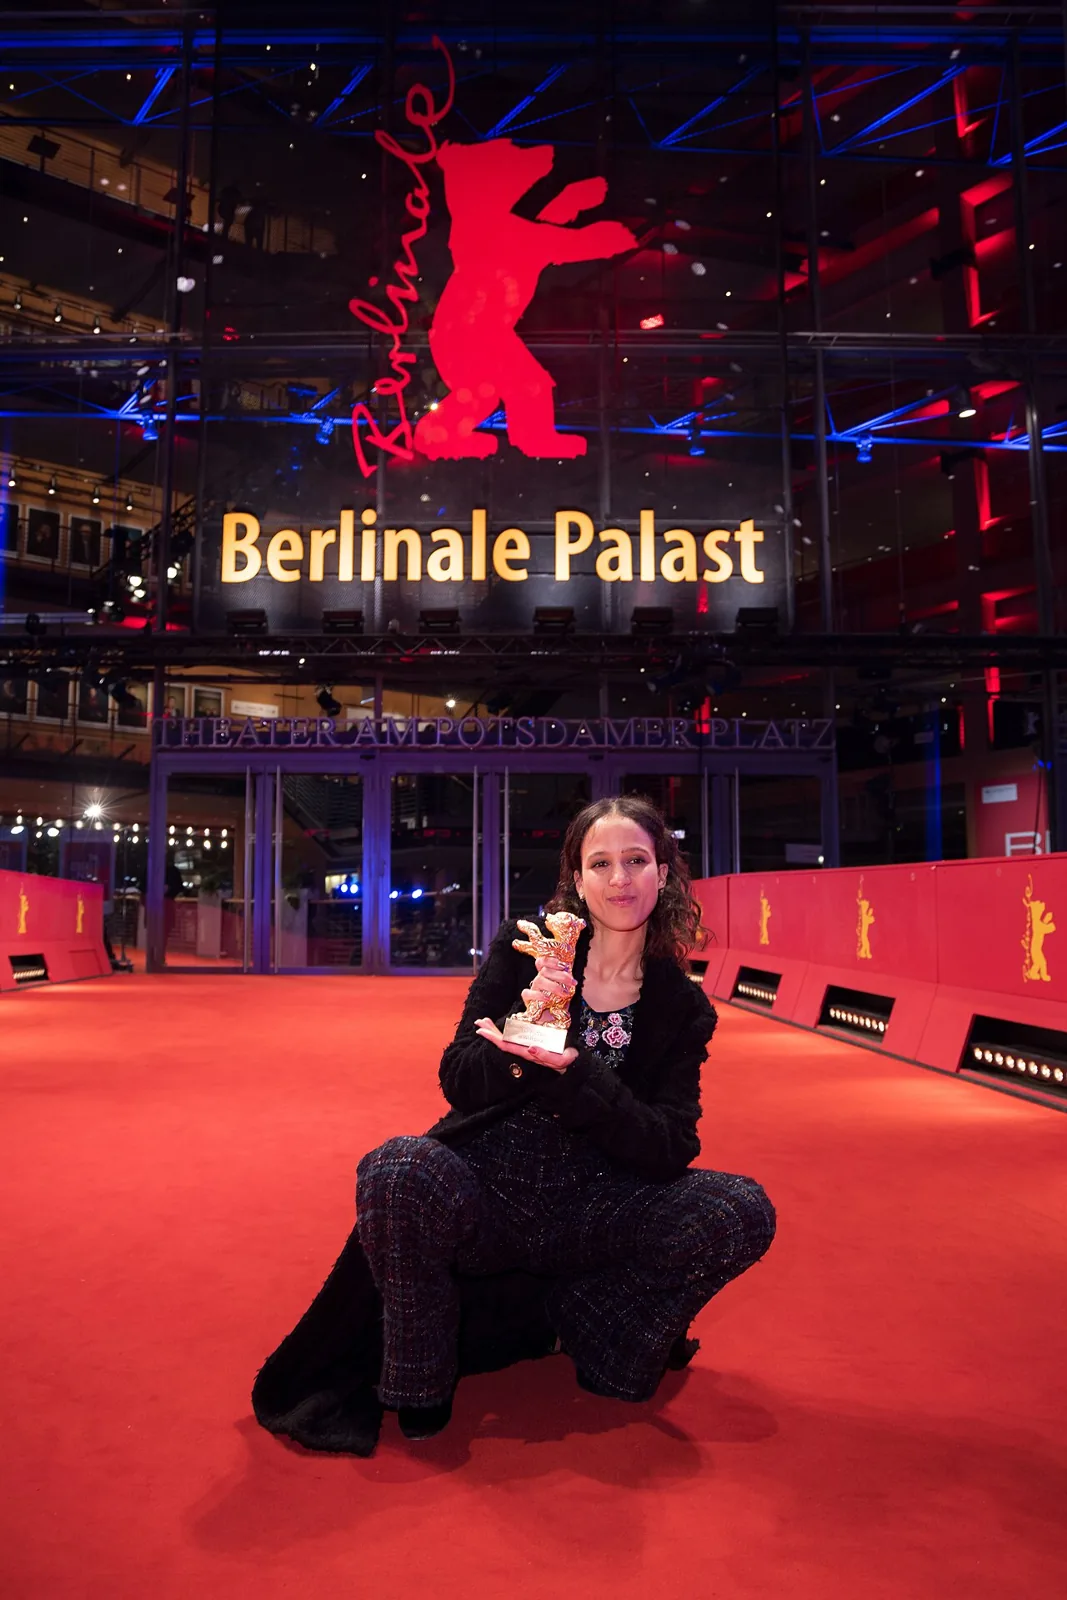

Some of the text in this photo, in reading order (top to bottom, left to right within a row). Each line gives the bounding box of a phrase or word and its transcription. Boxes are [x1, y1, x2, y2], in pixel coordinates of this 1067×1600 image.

[349, 34, 456, 478] Berlinale
[221, 508, 765, 584] Berlinale Palast
[153, 715, 836, 749] THEATER AM POTSDAMER PLATZ
